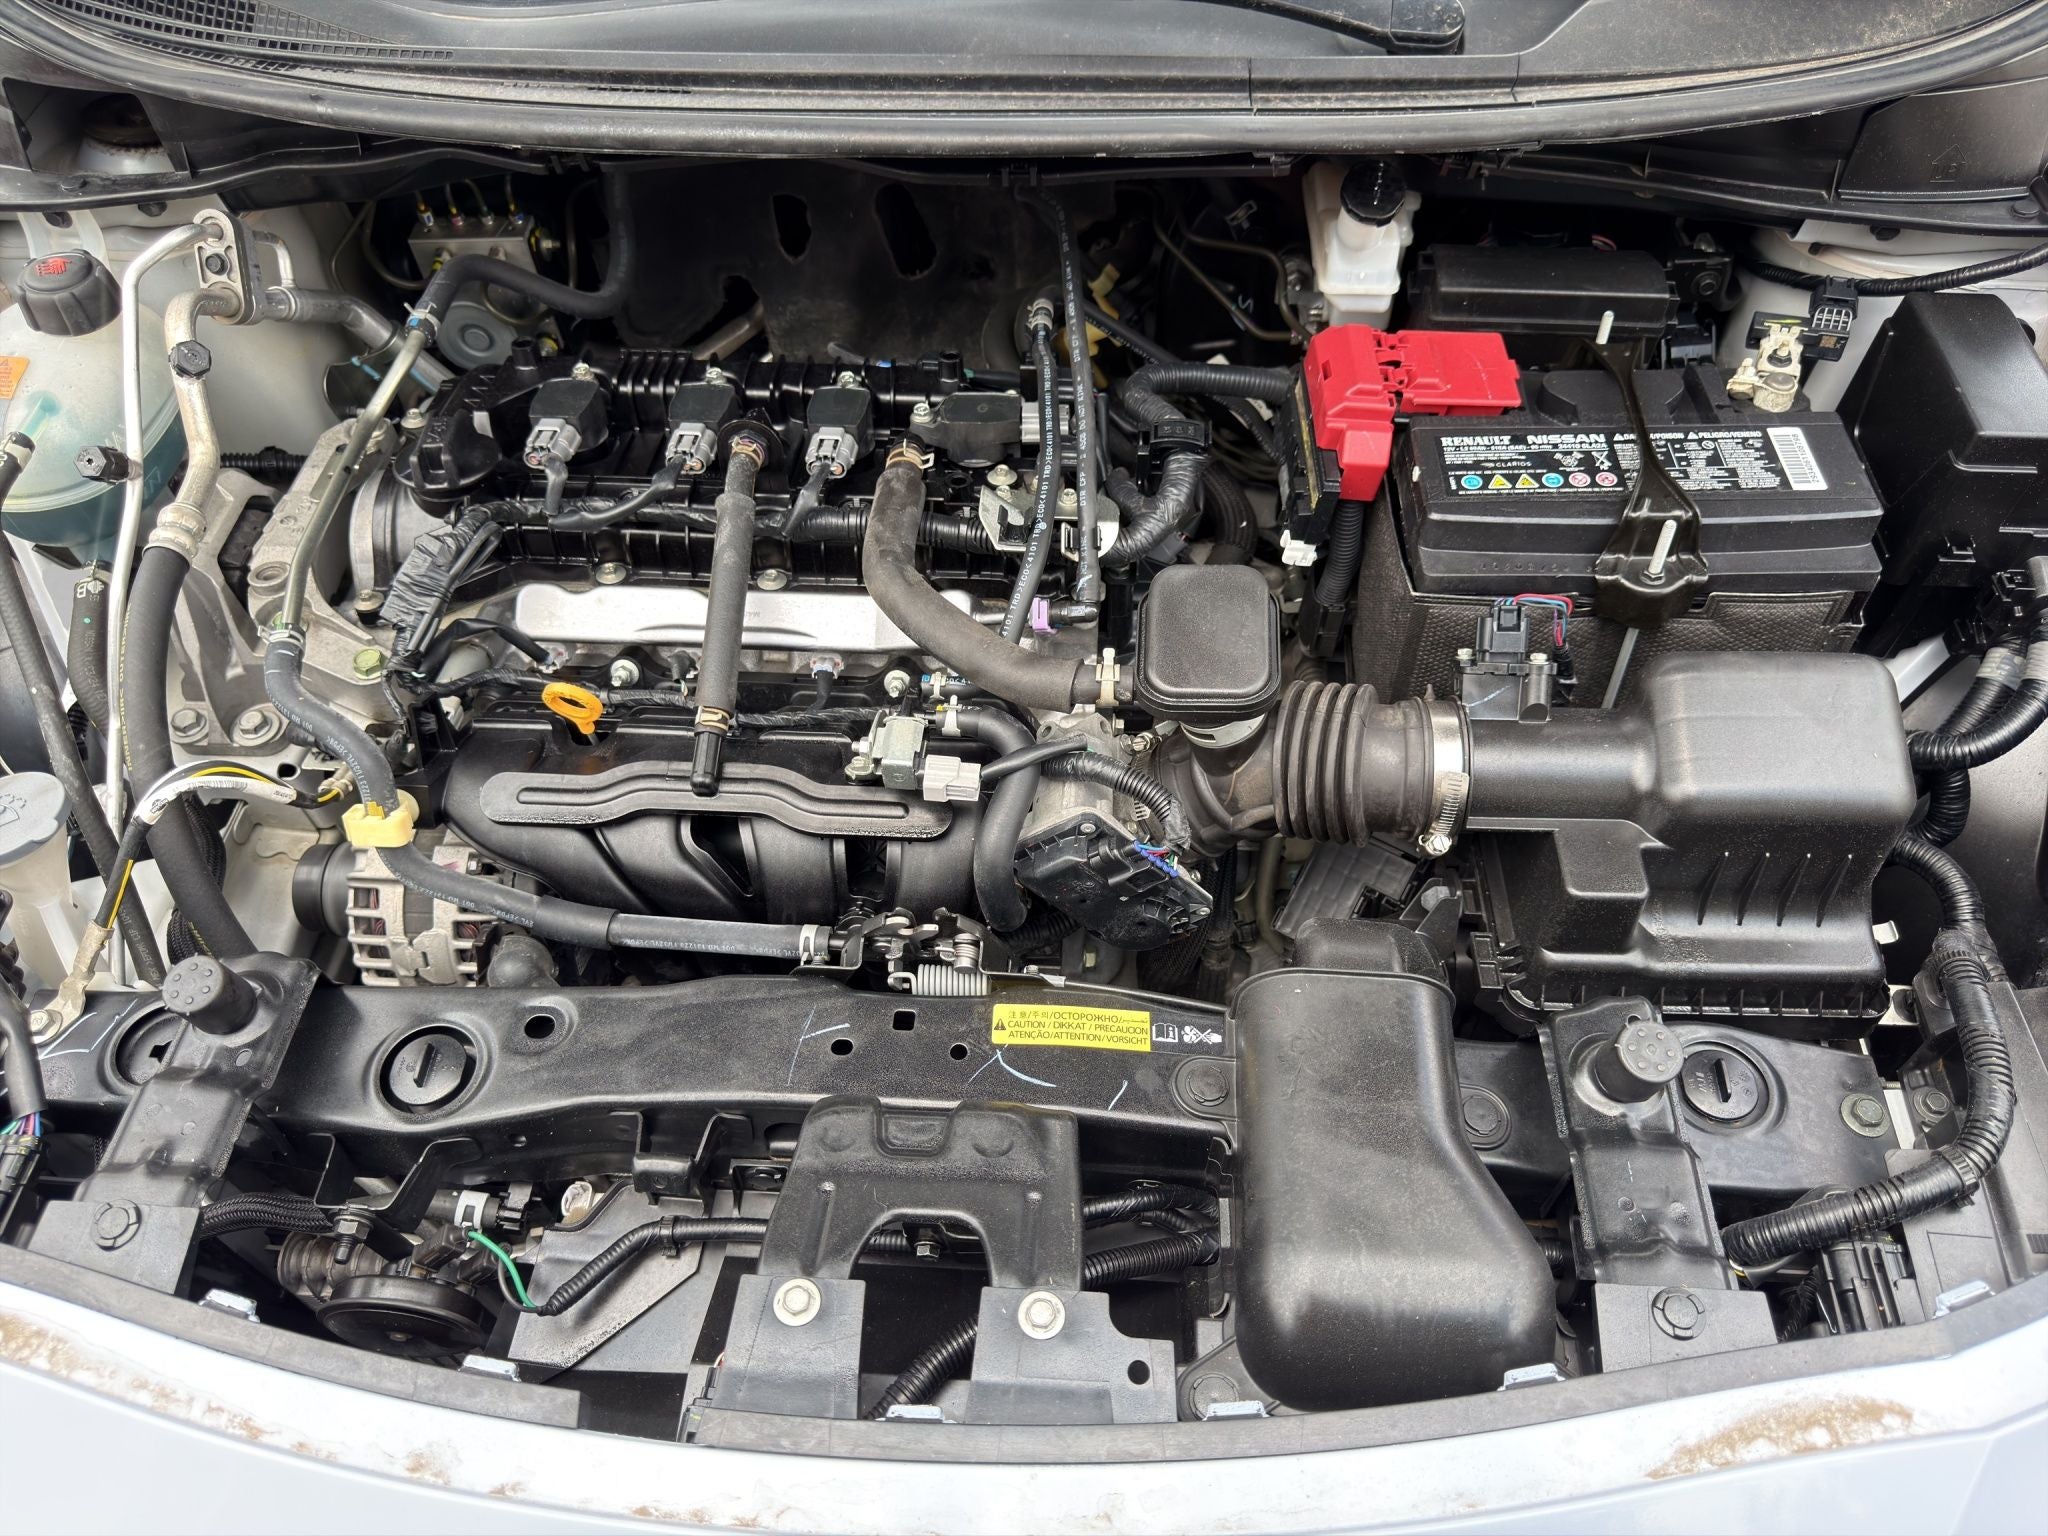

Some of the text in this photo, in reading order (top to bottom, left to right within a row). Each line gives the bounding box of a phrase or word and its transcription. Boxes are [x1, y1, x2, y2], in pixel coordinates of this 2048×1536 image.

[1440, 433, 1607, 447] RENAULT NISSAN
[1698, 430, 1763, 439] PELIGRO/VENENO
[1008, 1020, 1046, 1029] CAUTION
[1053, 1022, 1087, 1031] DIKKAT
